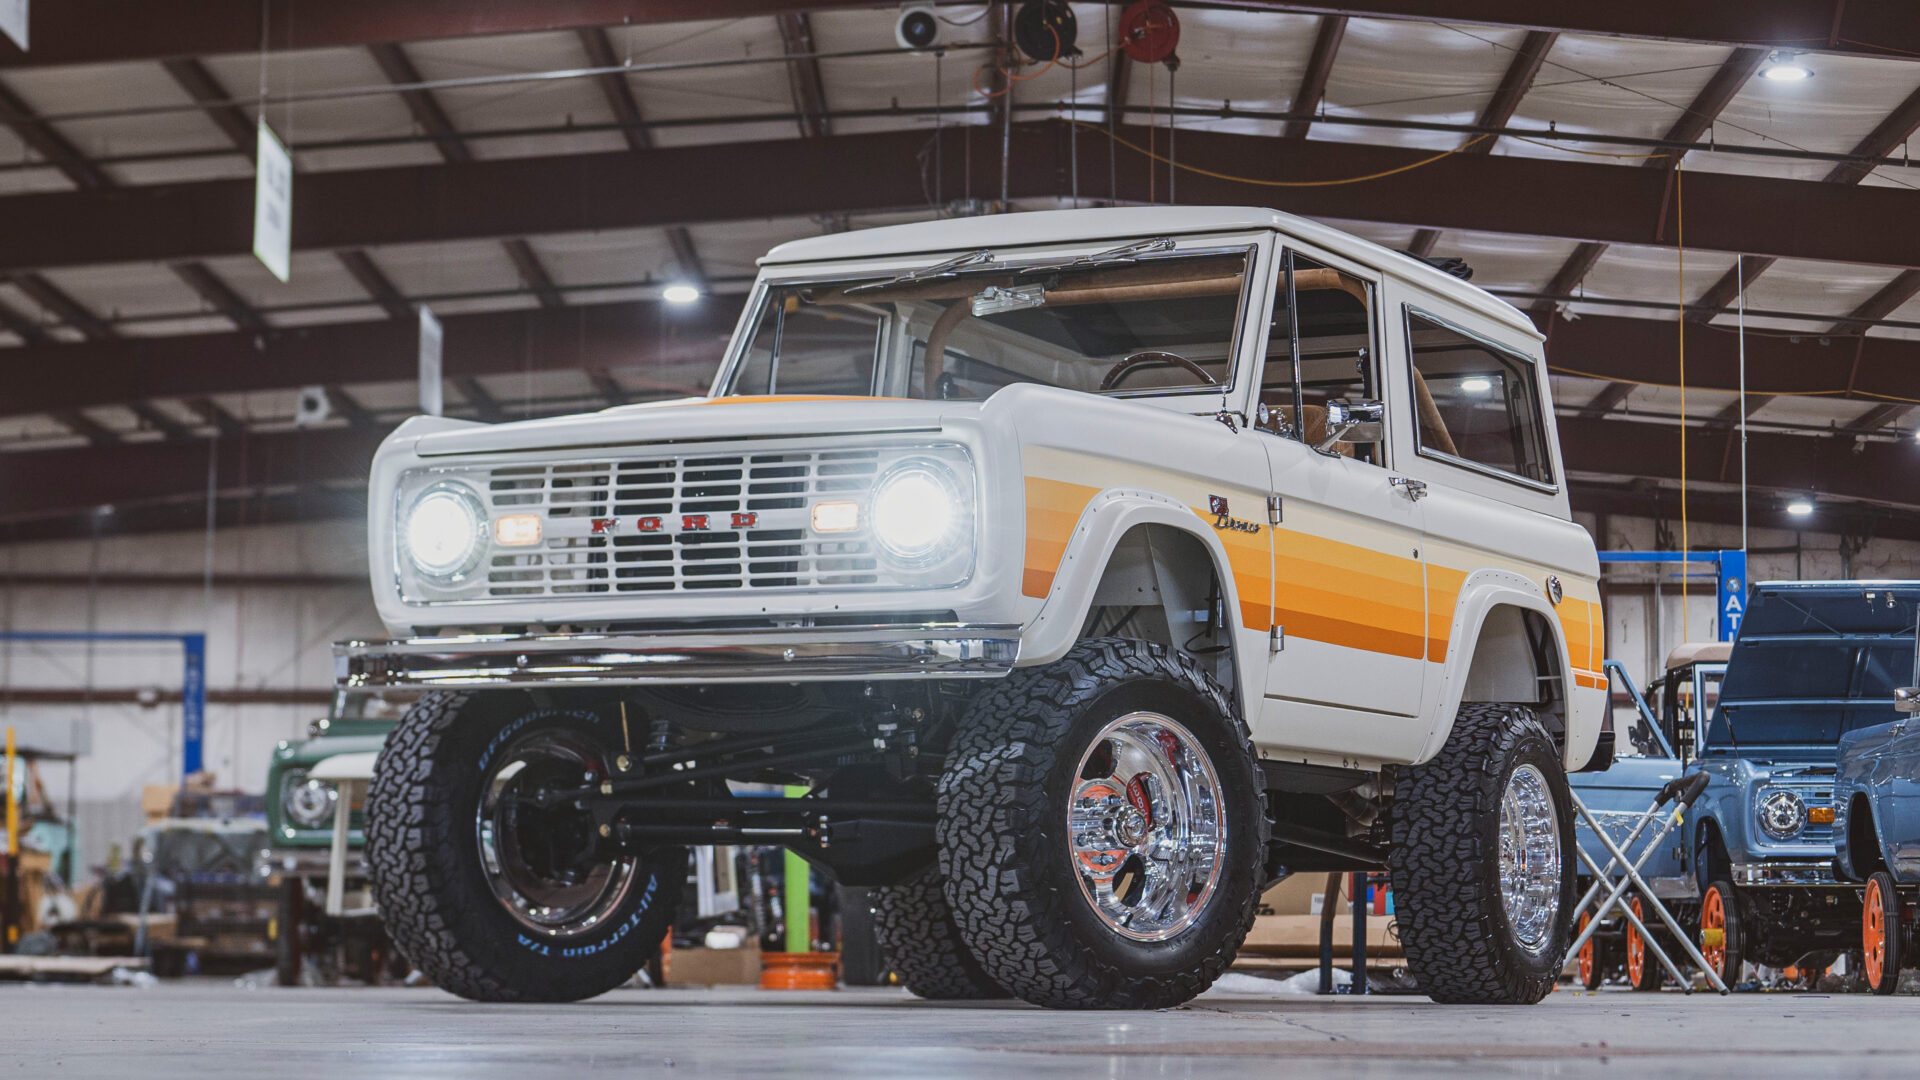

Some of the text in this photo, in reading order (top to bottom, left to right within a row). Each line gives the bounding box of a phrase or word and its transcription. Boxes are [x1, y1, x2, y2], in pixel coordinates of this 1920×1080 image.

[591, 512, 759, 534] FORD
[518, 874, 658, 957] All-Terrain T/A
